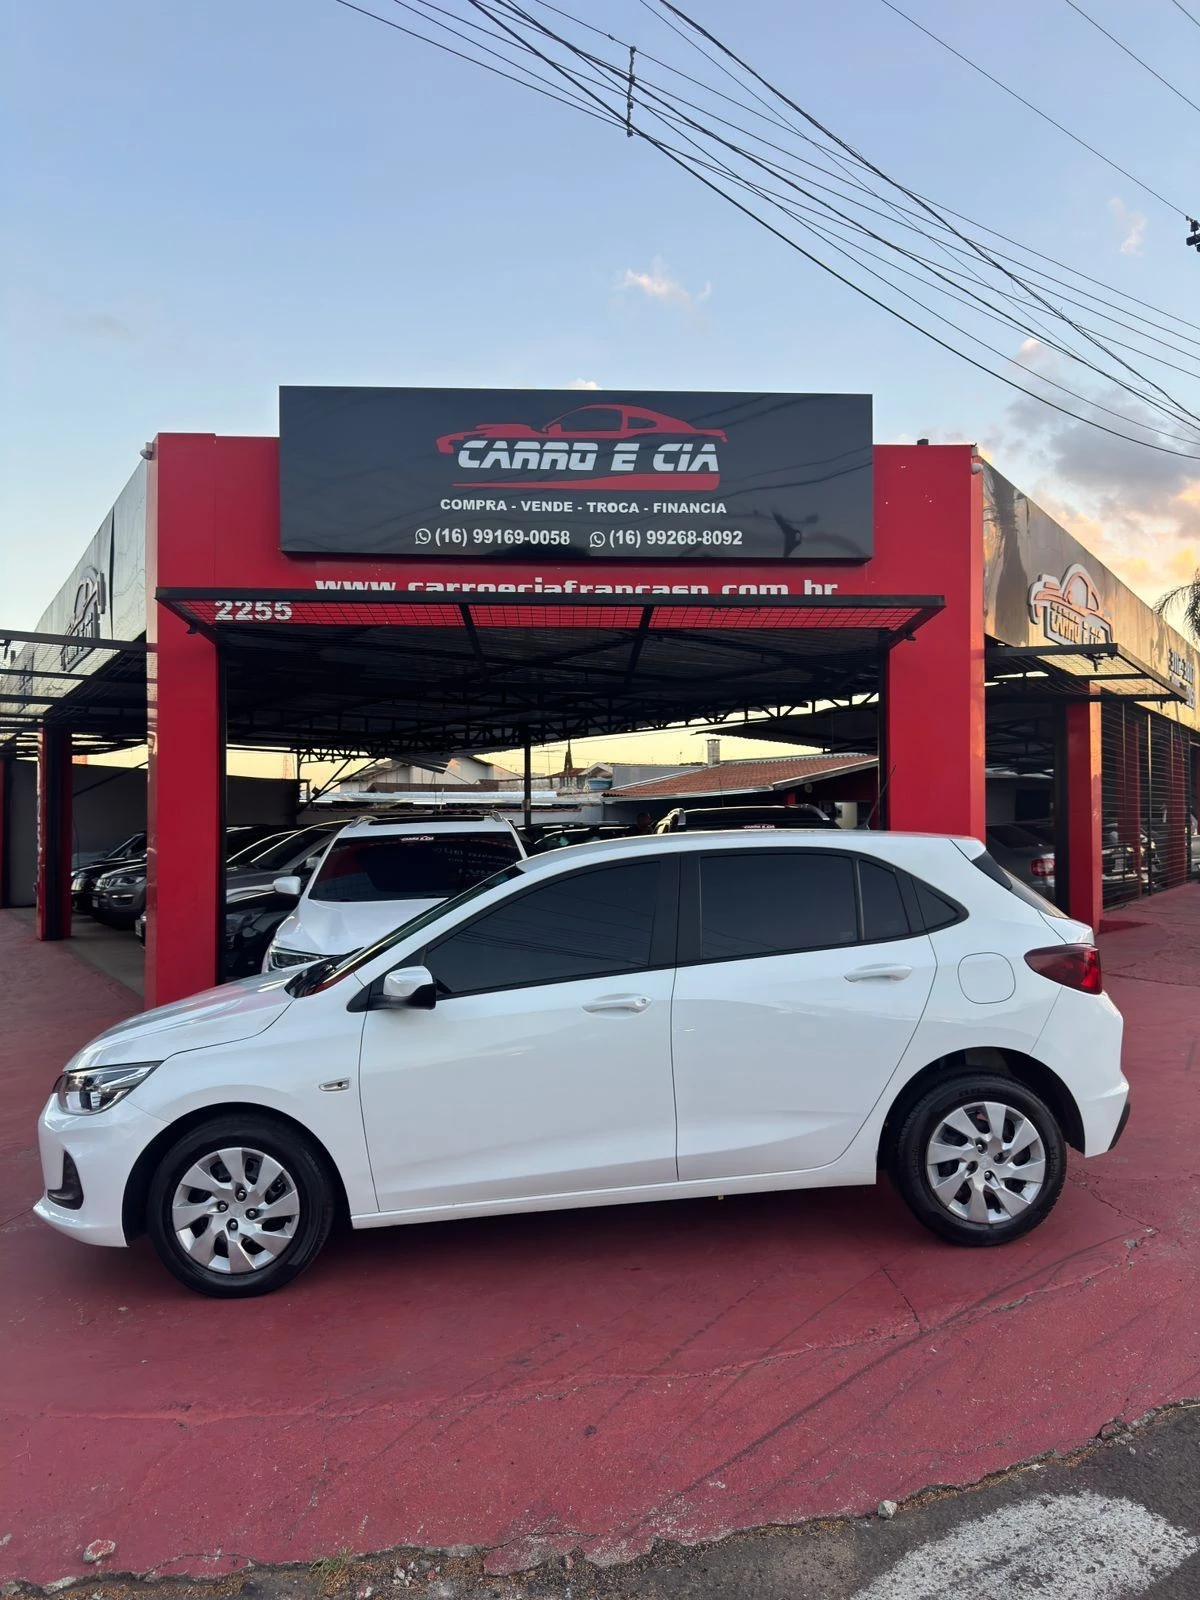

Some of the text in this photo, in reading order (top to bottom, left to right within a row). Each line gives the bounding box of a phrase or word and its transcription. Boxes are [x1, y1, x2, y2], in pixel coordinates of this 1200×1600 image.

[458, 440, 719, 472] CARRO E CIA
[440, 499, 508, 511] COMPRA
[520, 501, 573, 512] VENDE
[586, 502, 640, 513] TROCA
[653, 502, 727, 514] FINANCIA
[435, 527, 571, 547] (16) 99169-0058
[609, 530, 743, 548] (16) 99268-8092
[315, 577, 839, 595] wwwcarroeciafrancascombr
[214, 600, 293, 621] 2255
